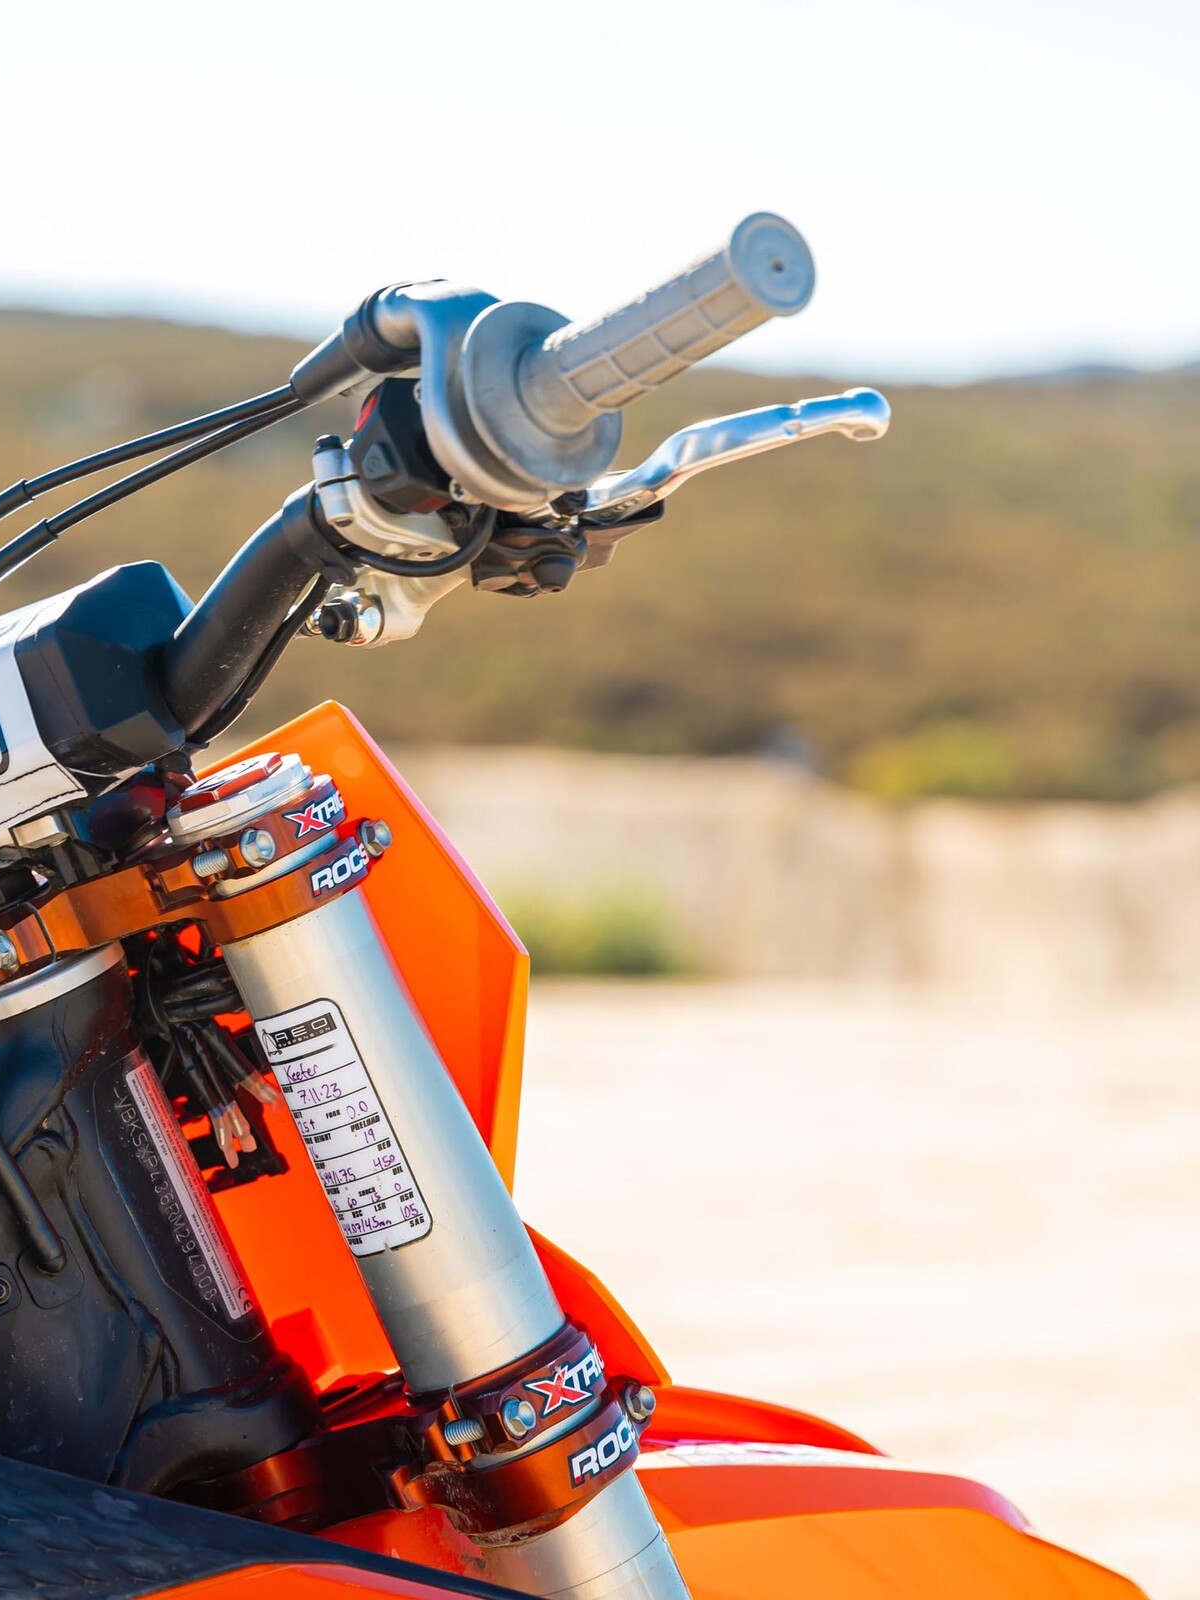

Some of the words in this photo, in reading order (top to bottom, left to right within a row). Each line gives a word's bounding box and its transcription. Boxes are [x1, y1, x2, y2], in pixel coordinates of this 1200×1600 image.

[350, 1114, 381, 1133] PRELOAD
[363, 1128, 376, 1144] 19
[377, 1140, 392, 1152] REB
[409, 1216, 426, 1228] SAG
